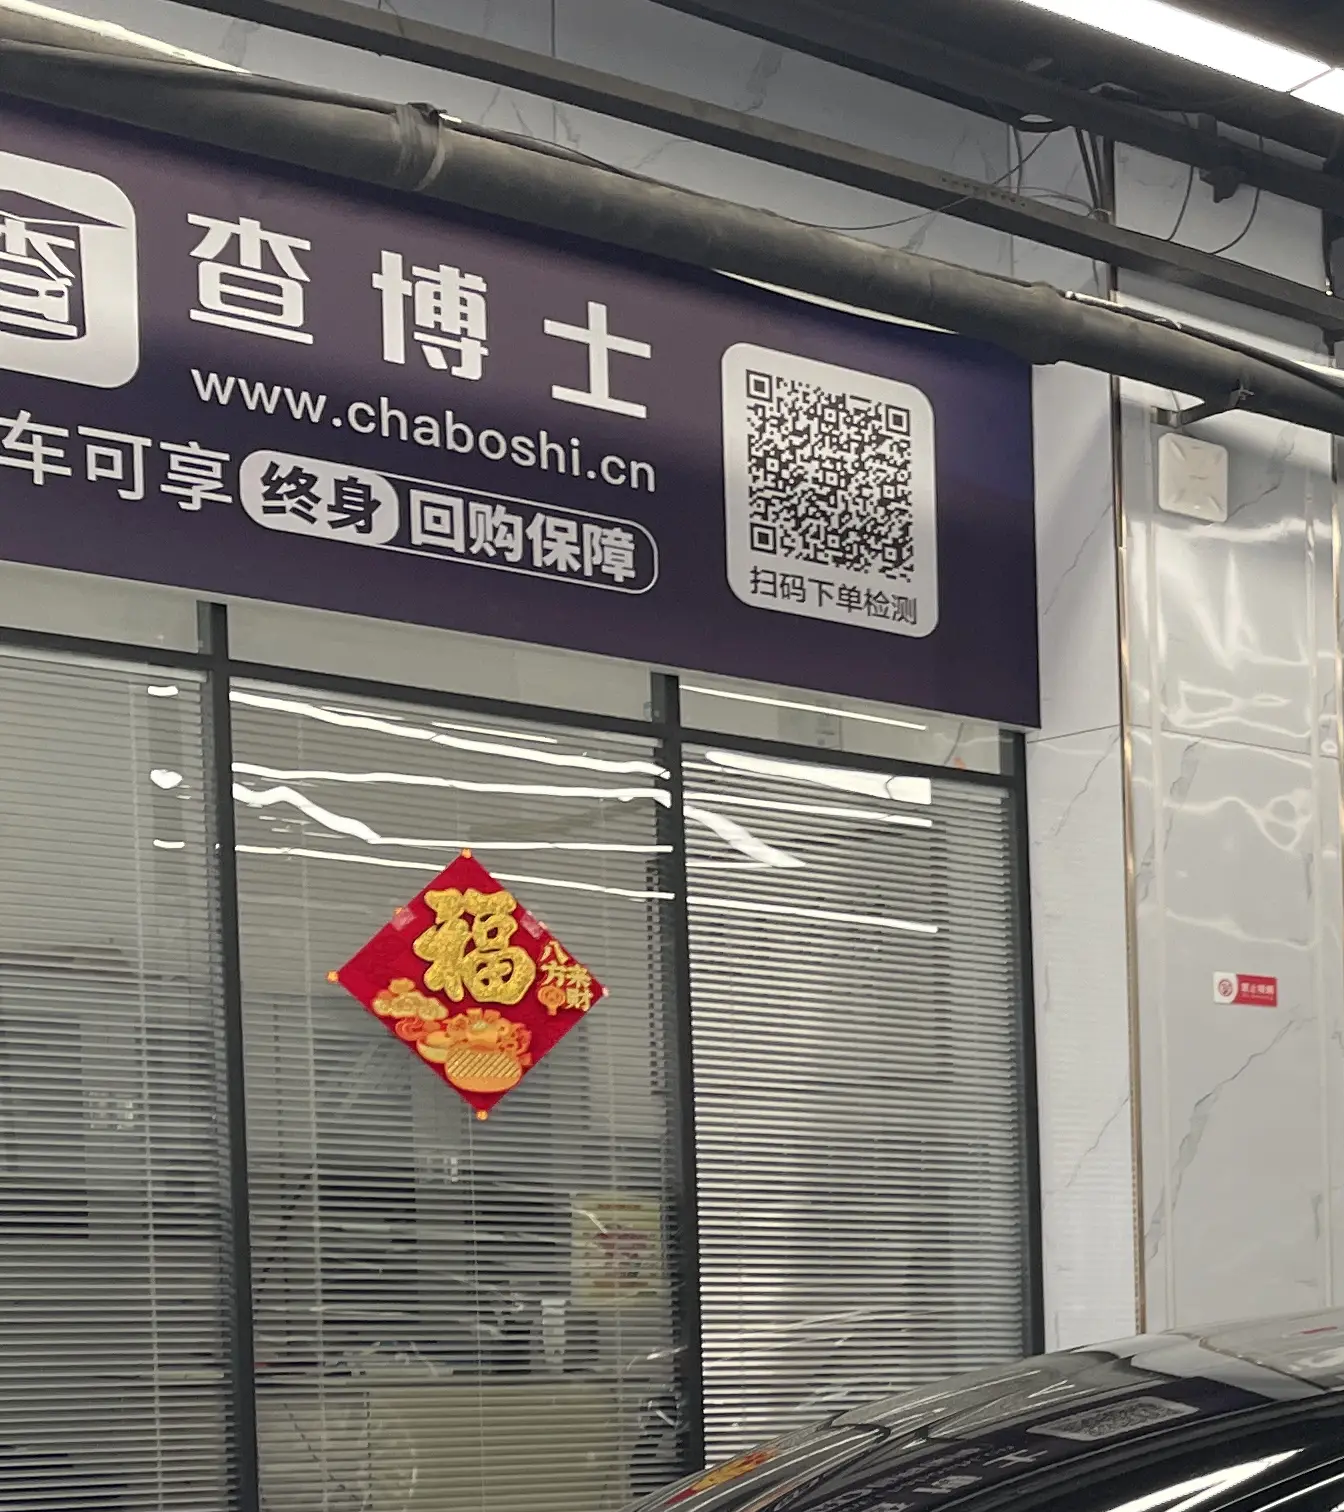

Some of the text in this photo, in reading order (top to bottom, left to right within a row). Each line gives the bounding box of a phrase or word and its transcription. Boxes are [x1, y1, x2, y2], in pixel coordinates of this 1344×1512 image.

[187, 213, 652, 419] 查博士
[191, 368, 655, 492] www.chaboshi.cn
[0, 410, 636, 583] 车可享 终身 回购保障
[750, 565, 917, 625] 扫码下单检测
[413, 888, 537, 1005] 福
